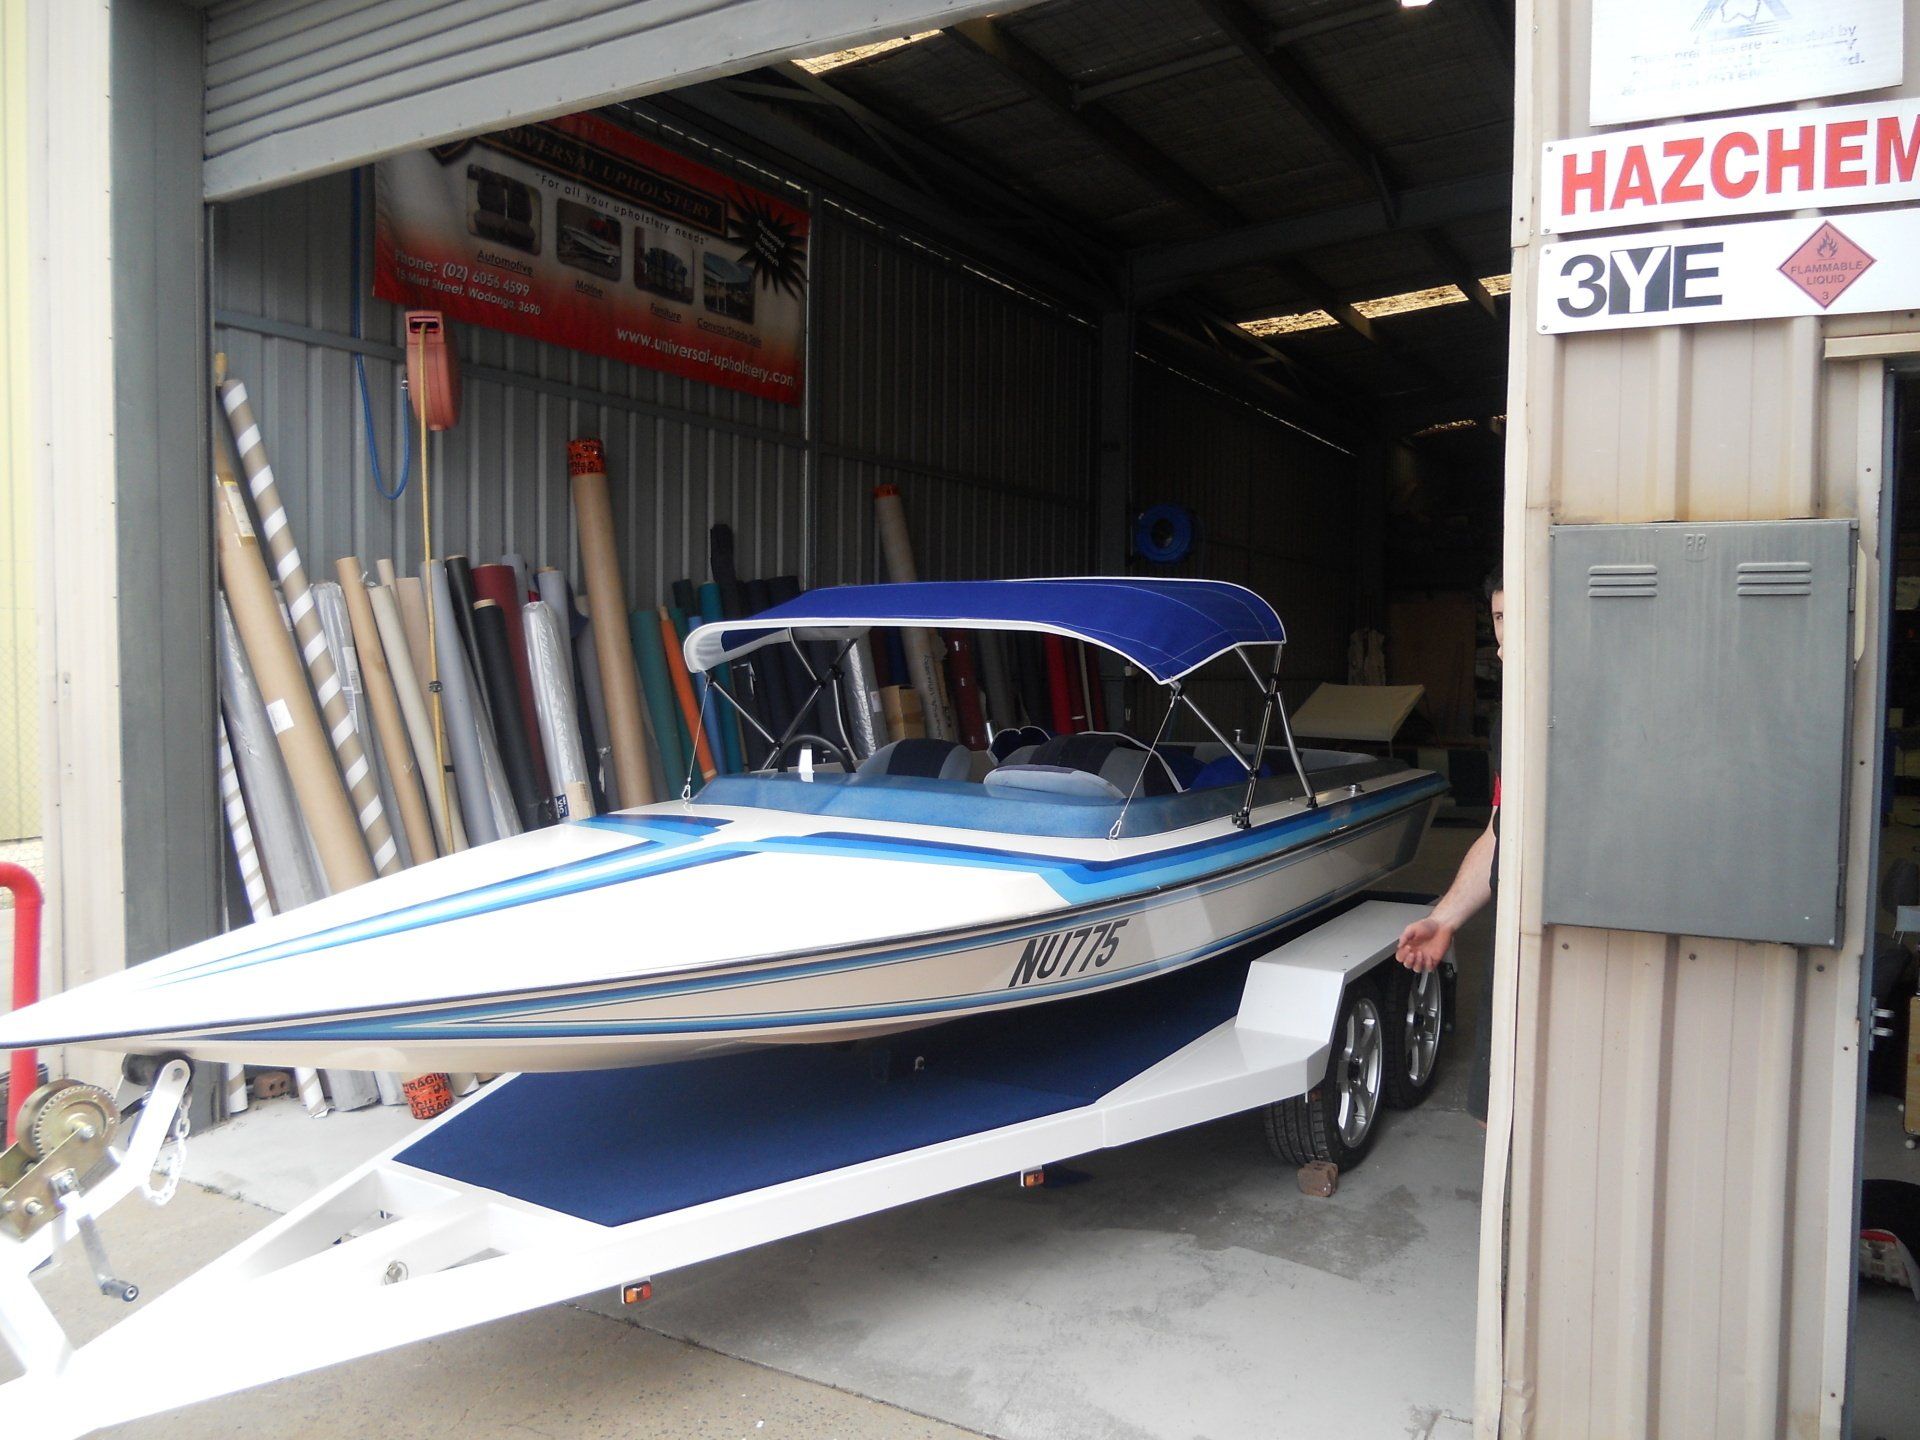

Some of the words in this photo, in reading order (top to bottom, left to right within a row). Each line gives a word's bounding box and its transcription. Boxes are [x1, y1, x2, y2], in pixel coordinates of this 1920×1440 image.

[508, 128, 598, 175] NIVERSAL
[1561, 113, 1920, 216] HAZCHEM
[565, 185, 581, 197] all
[586, 193, 610, 208] your
[614, 203, 671, 234] upholstery
[395, 249, 439, 273] Phone:
[442, 261, 469, 283] (02)
[503, 279, 531, 297] 4599
[477, 249, 534, 275] Automotive
[1557, 242, 1724, 318] 3YE
[1790, 260, 1864, 275] FLAMMABLE
[1806, 274, 1846, 286] LIQUID
[518, 300, 542, 317] 3690
[1822, 291, 1830, 300] 3
[1008, 918, 1130, 988] NU775
